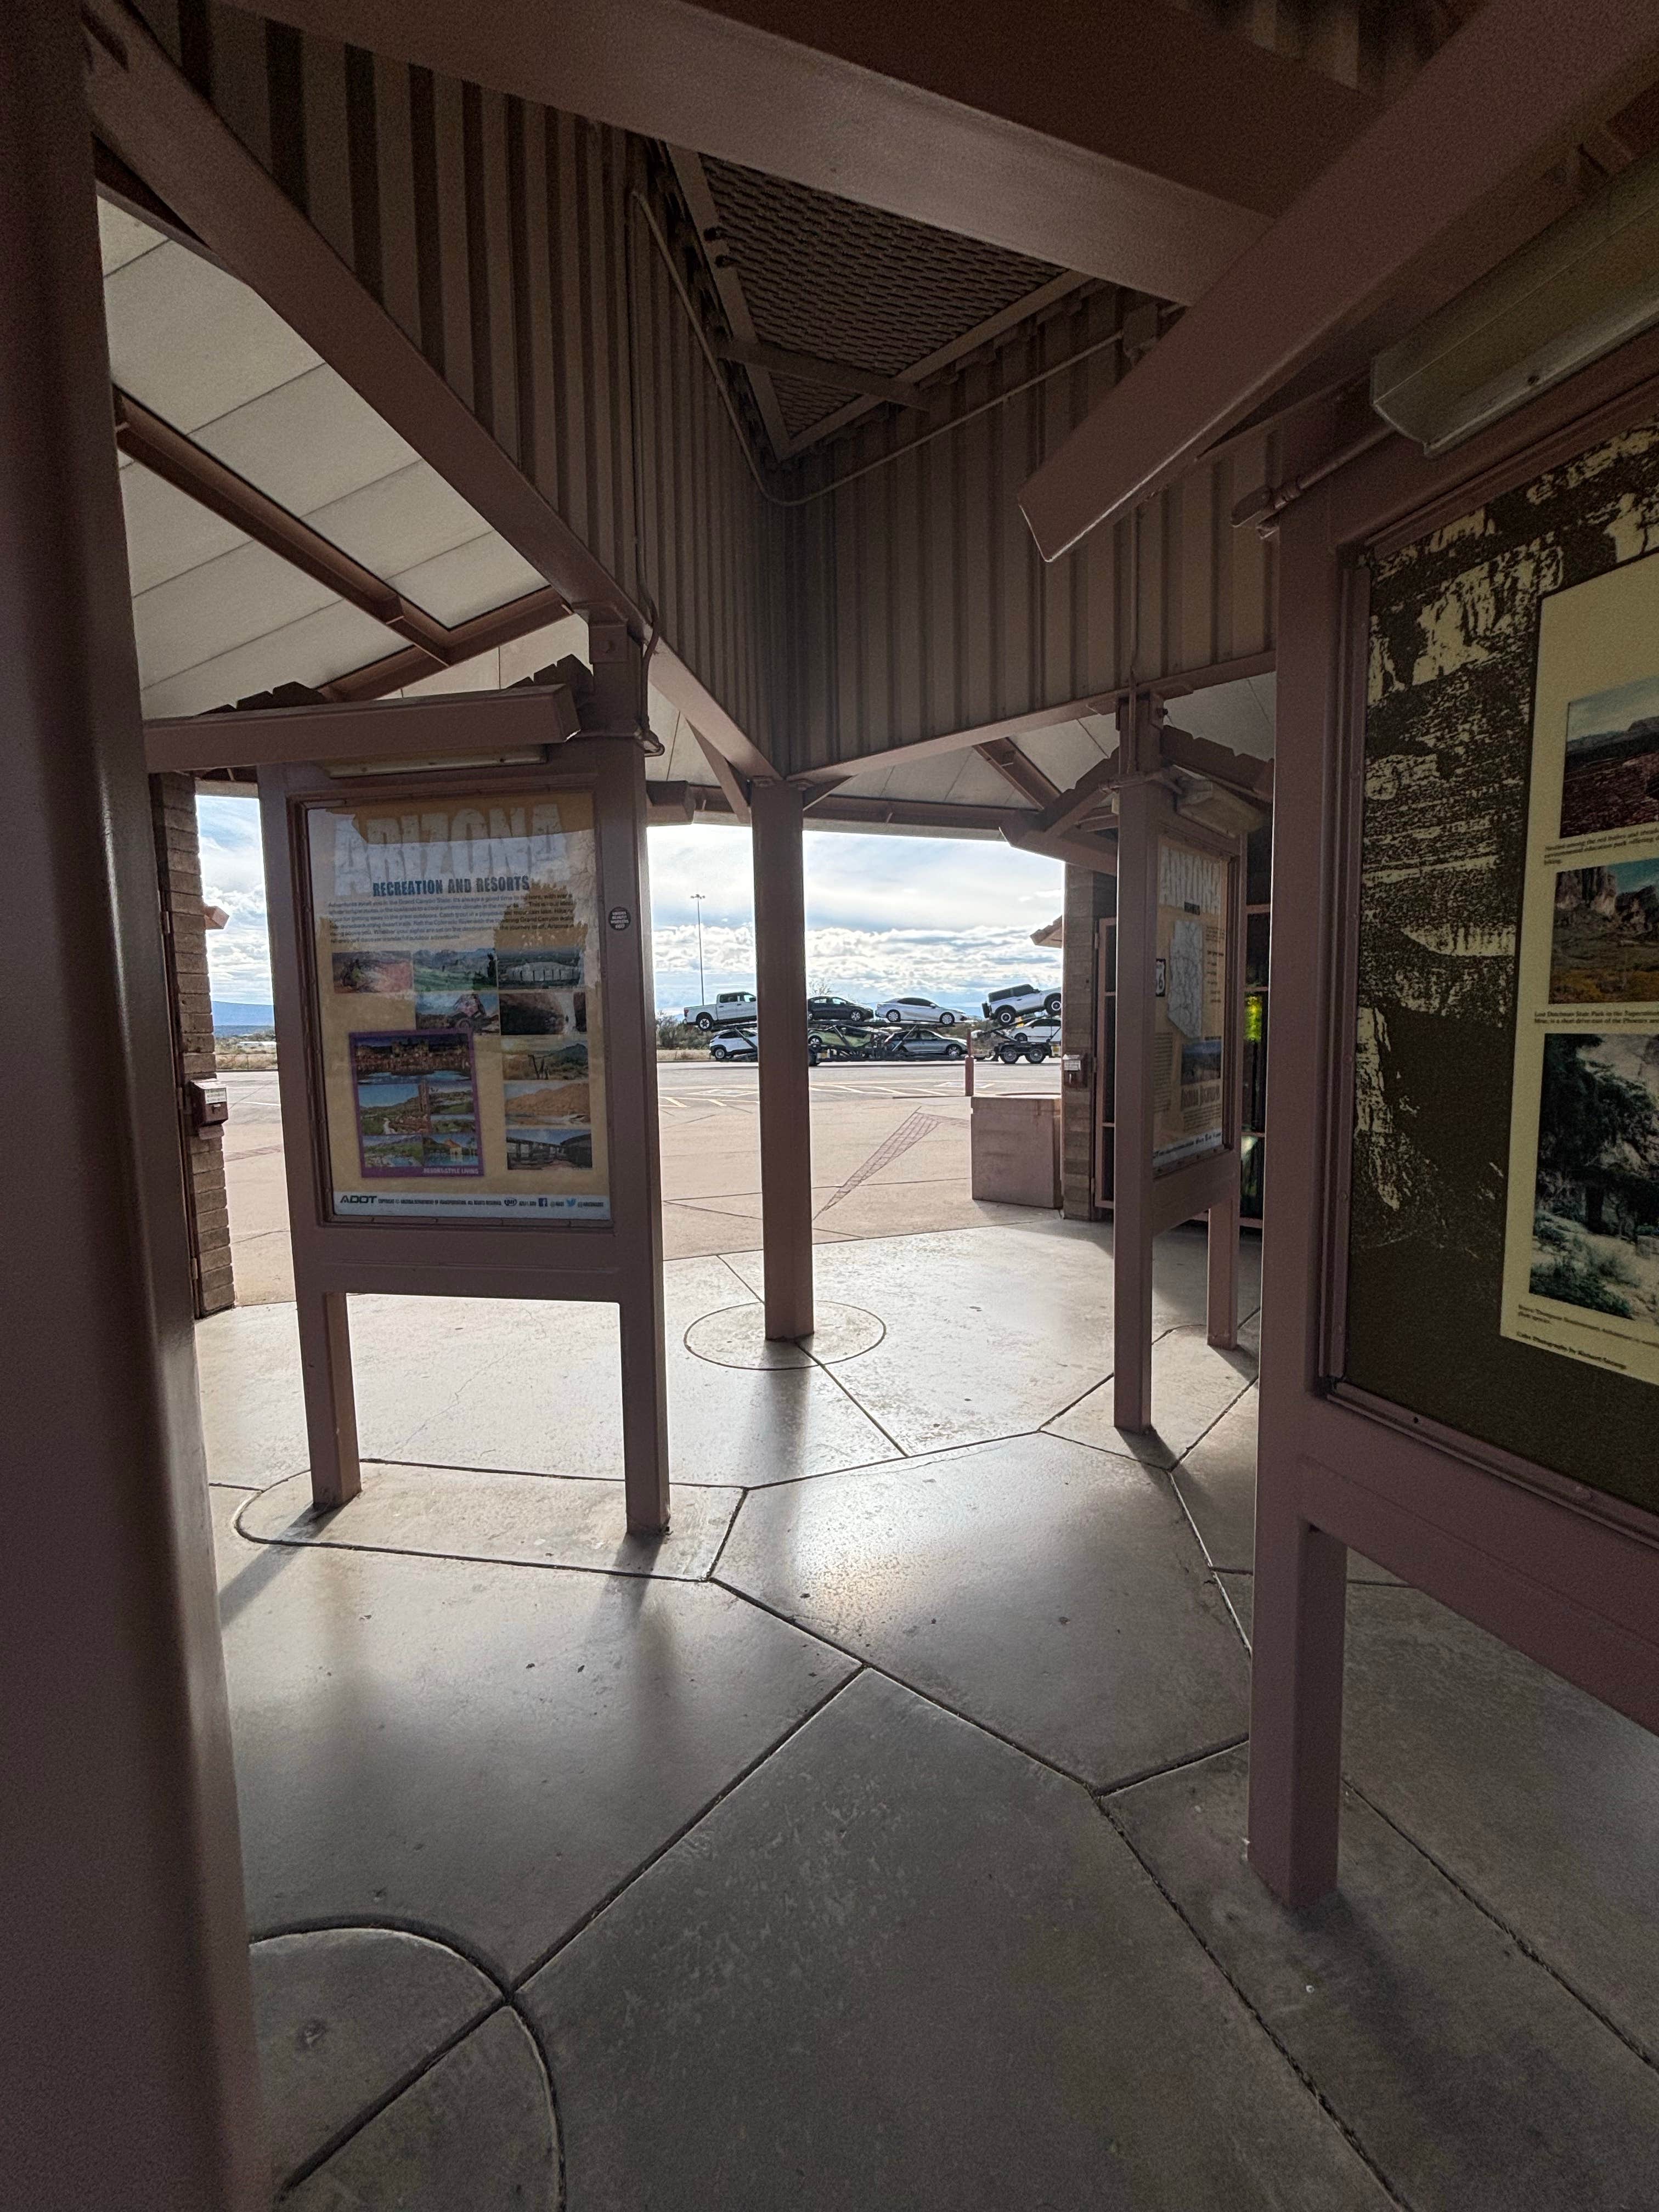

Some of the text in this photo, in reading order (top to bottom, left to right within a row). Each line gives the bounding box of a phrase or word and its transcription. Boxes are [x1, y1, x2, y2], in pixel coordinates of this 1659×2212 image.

[334, 804, 568, 896] ARIZONA
[372, 876, 530, 898] RECREATION AND RESORTS
[340, 1195, 377, 1204] ADOT
